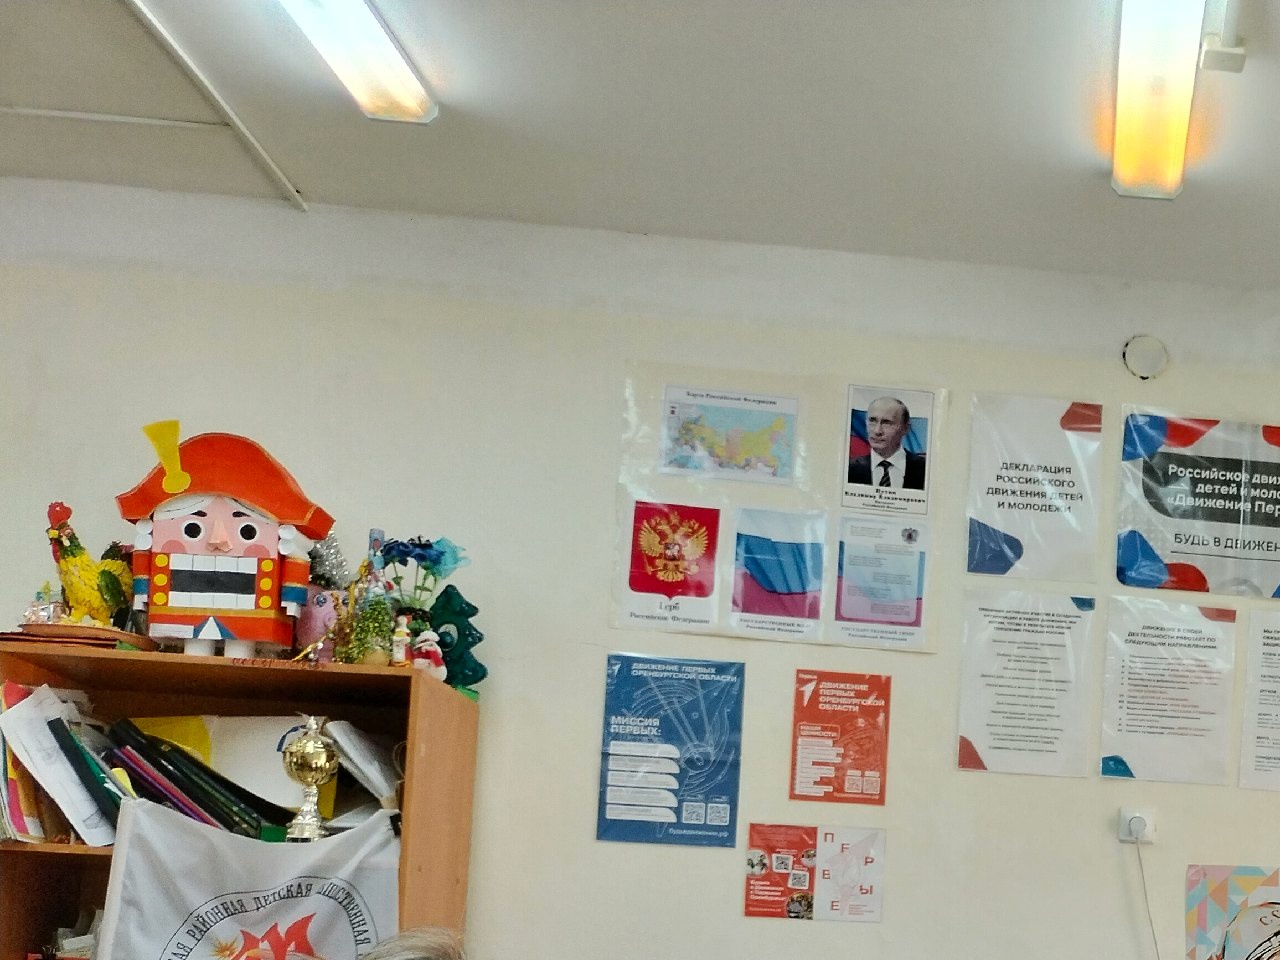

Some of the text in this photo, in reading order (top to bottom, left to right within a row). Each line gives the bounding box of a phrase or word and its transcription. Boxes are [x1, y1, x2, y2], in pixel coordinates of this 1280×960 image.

[1000, 462, 1072, 474] ДЕКЛАРАЦИЯ
[1168, 464, 1250, 483] Российское
[996, 474, 1076, 488] РОССИЙСКОГО
[986, 487, 1047, 499] ДВИЖЕНИЯ
[1195, 483, 1238, 496] детей
[997, 501, 1005, 509] И
[1167, 493, 1252, 512] «Движение
[1174, 533, 1210, 546] БУДЬ
[1213, 536, 1221, 547] В
[610, 715, 660, 727] МИССИЯ
[186, 899, 248, 942] РАЙОННАЯ
[252, 882, 313, 912] ДЕТСКАЯ
